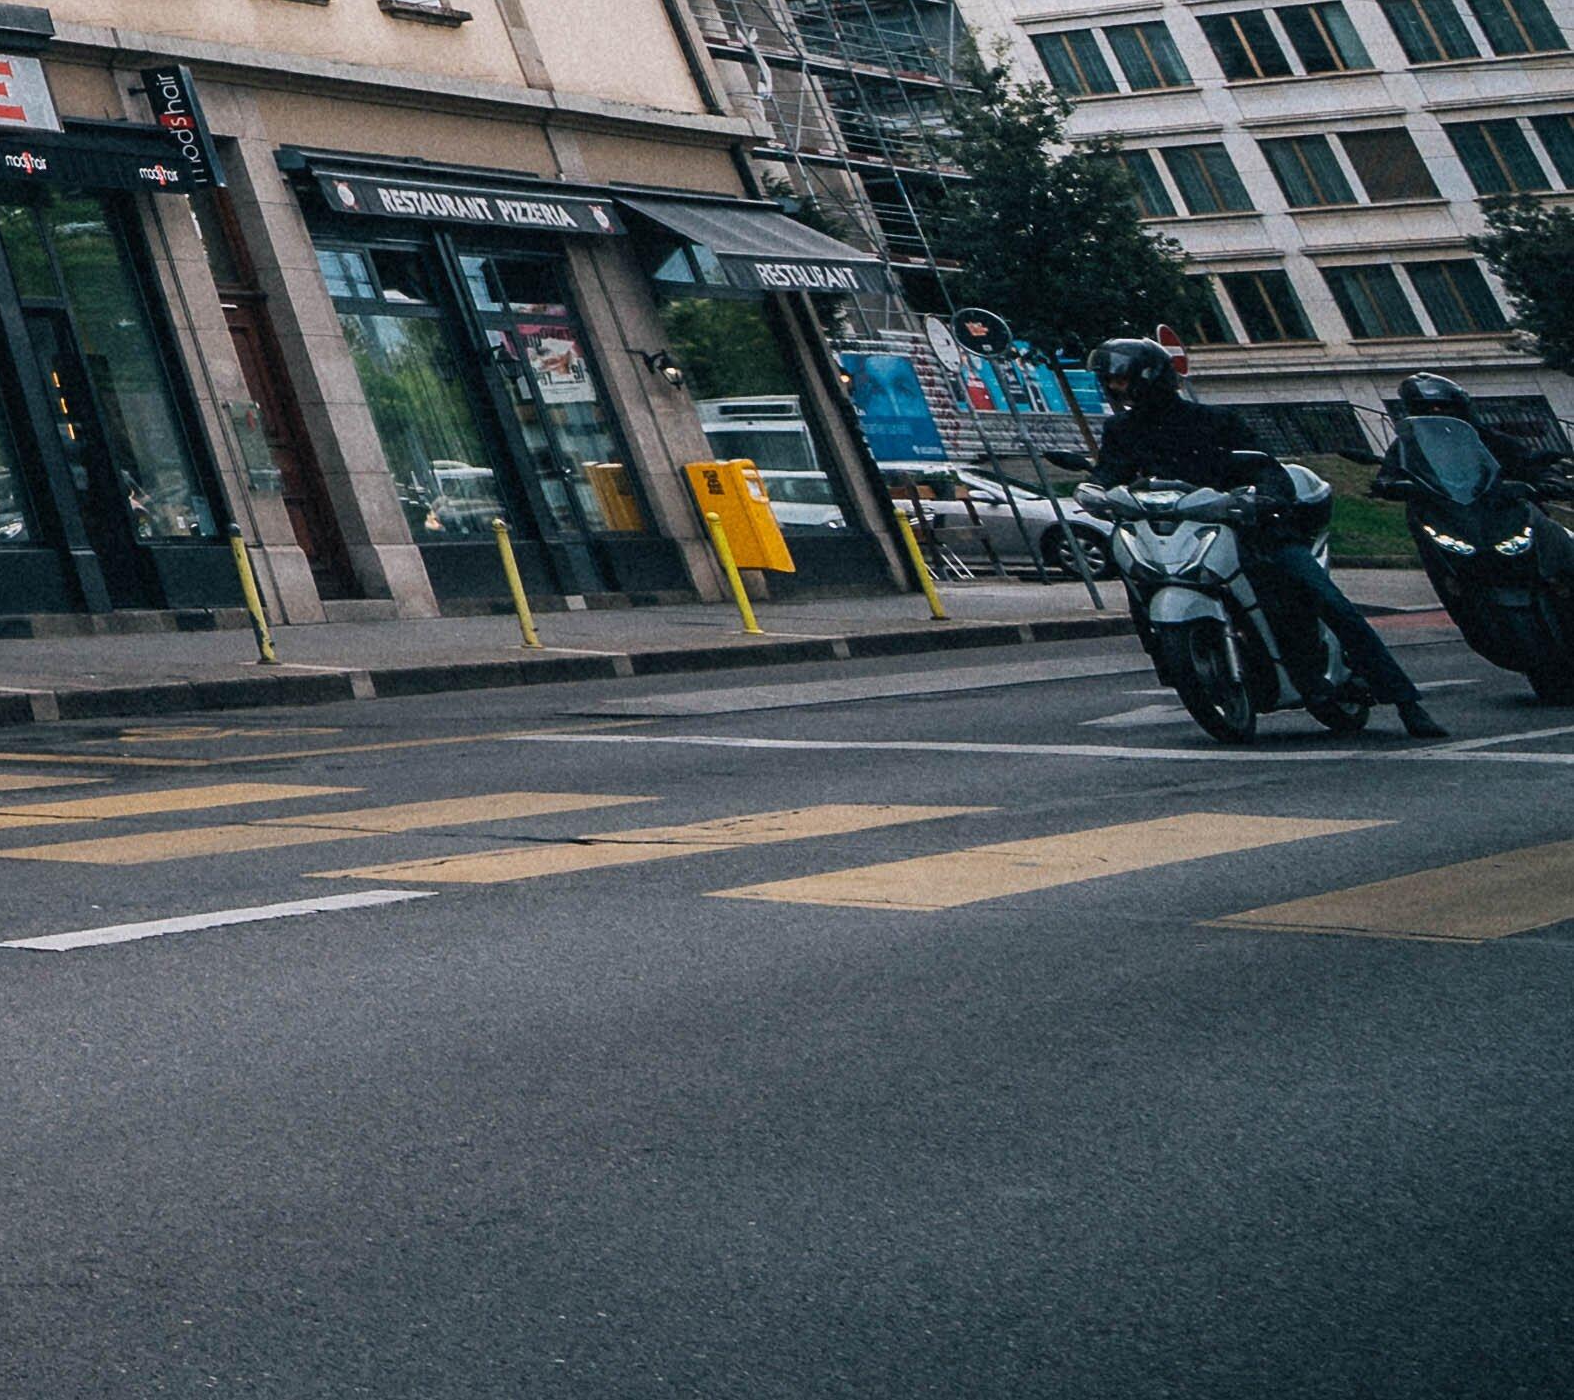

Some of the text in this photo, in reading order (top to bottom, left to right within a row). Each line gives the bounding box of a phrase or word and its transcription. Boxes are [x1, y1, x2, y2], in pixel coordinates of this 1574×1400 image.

[377, 187, 578, 228] RESTAURANT PIZZERIA
[754, 263, 860, 289] RESTAURANT
